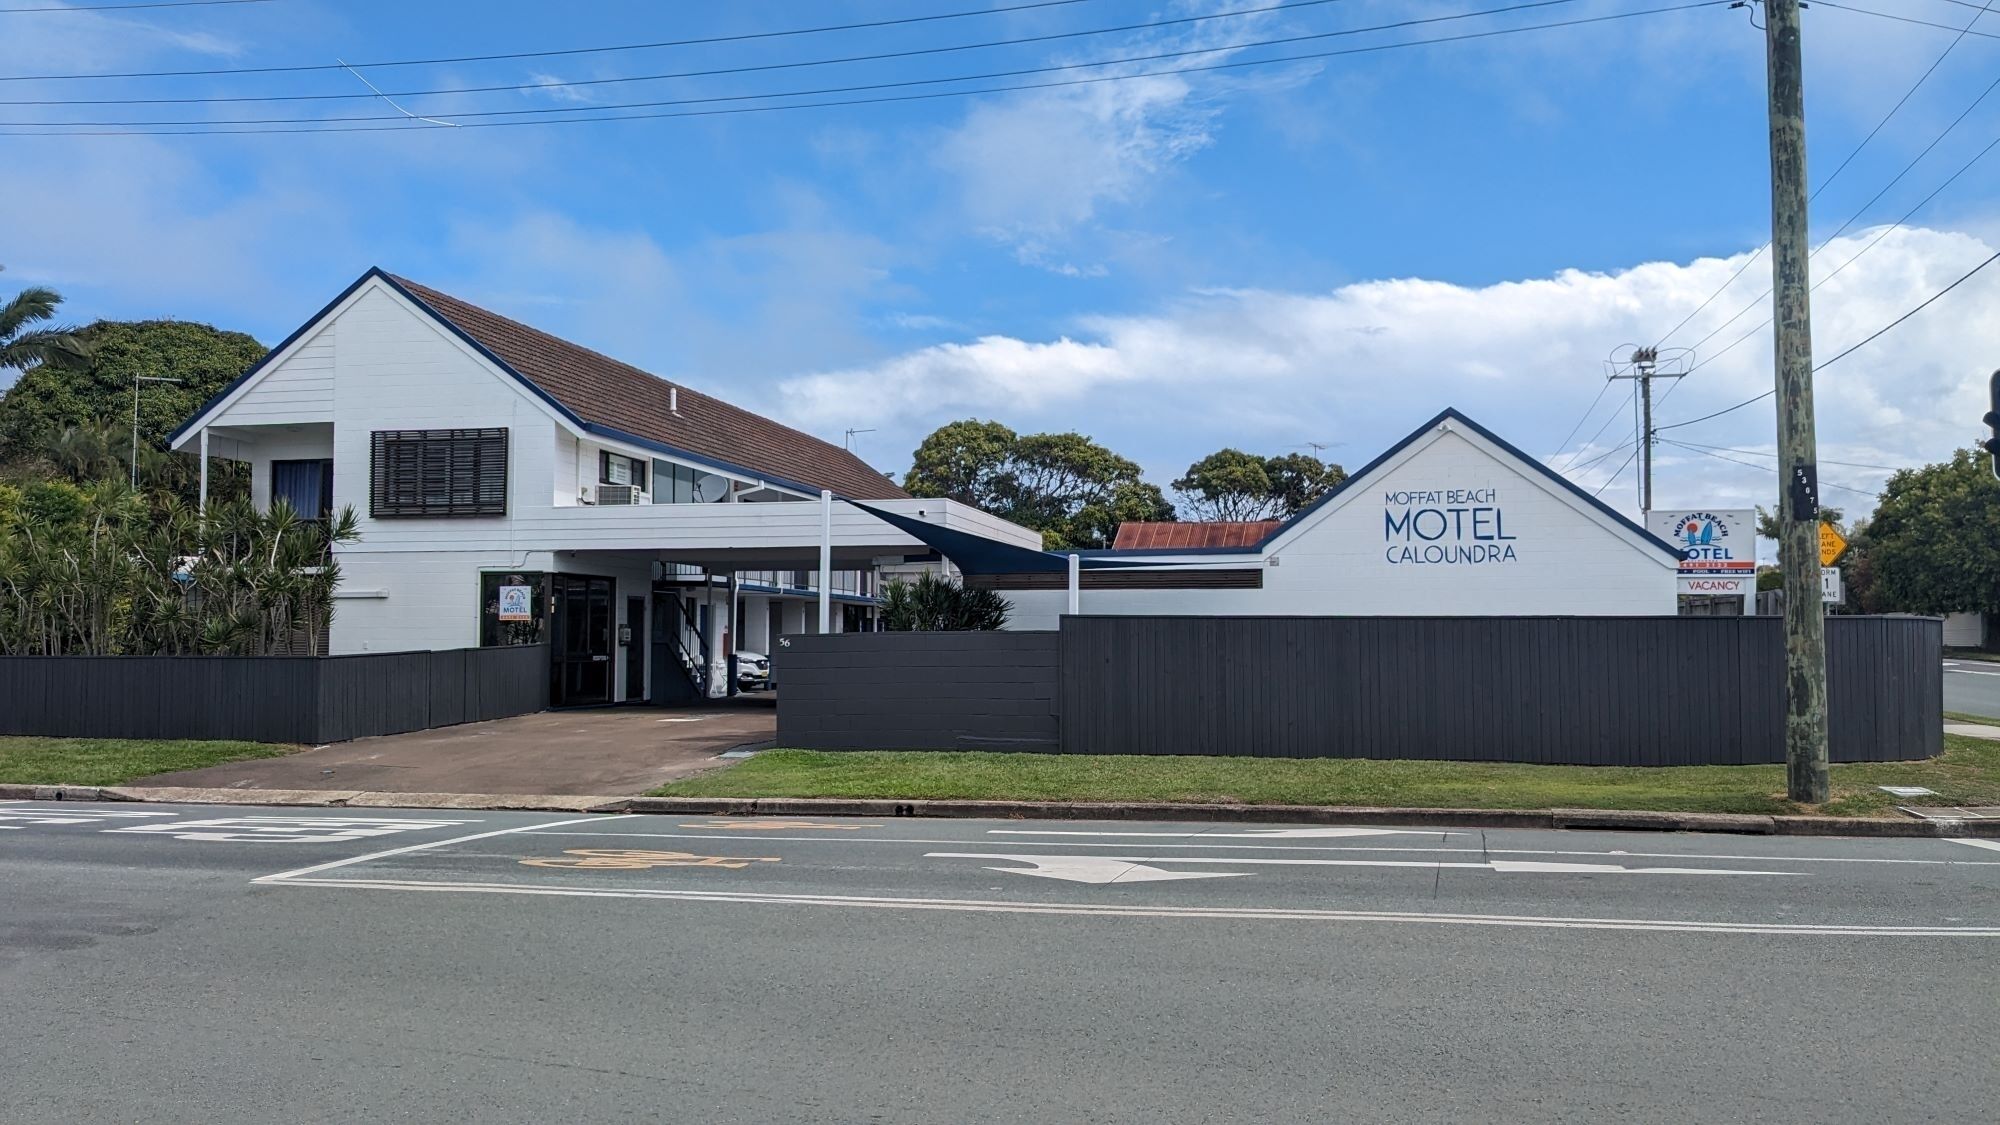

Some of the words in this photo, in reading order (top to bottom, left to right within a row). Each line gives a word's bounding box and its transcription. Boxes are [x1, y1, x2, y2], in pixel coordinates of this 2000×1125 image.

[1385, 490, 1443, 505] MOFFAT
[1446, 488, 1496, 504] BEACH
[1385, 507, 1517, 542] MOTEL
[1674, 512, 1703, 537] MOFFAT
[1704, 513, 1729, 537] BEACH
[1386, 544, 1517, 565] CALOUNDRA
[1682, 548, 1734, 560] OTEL
[1688, 580, 1740, 591] VACANCY
[1825, 578, 1829, 589] 1
[779, 638, 791, 647] 56
